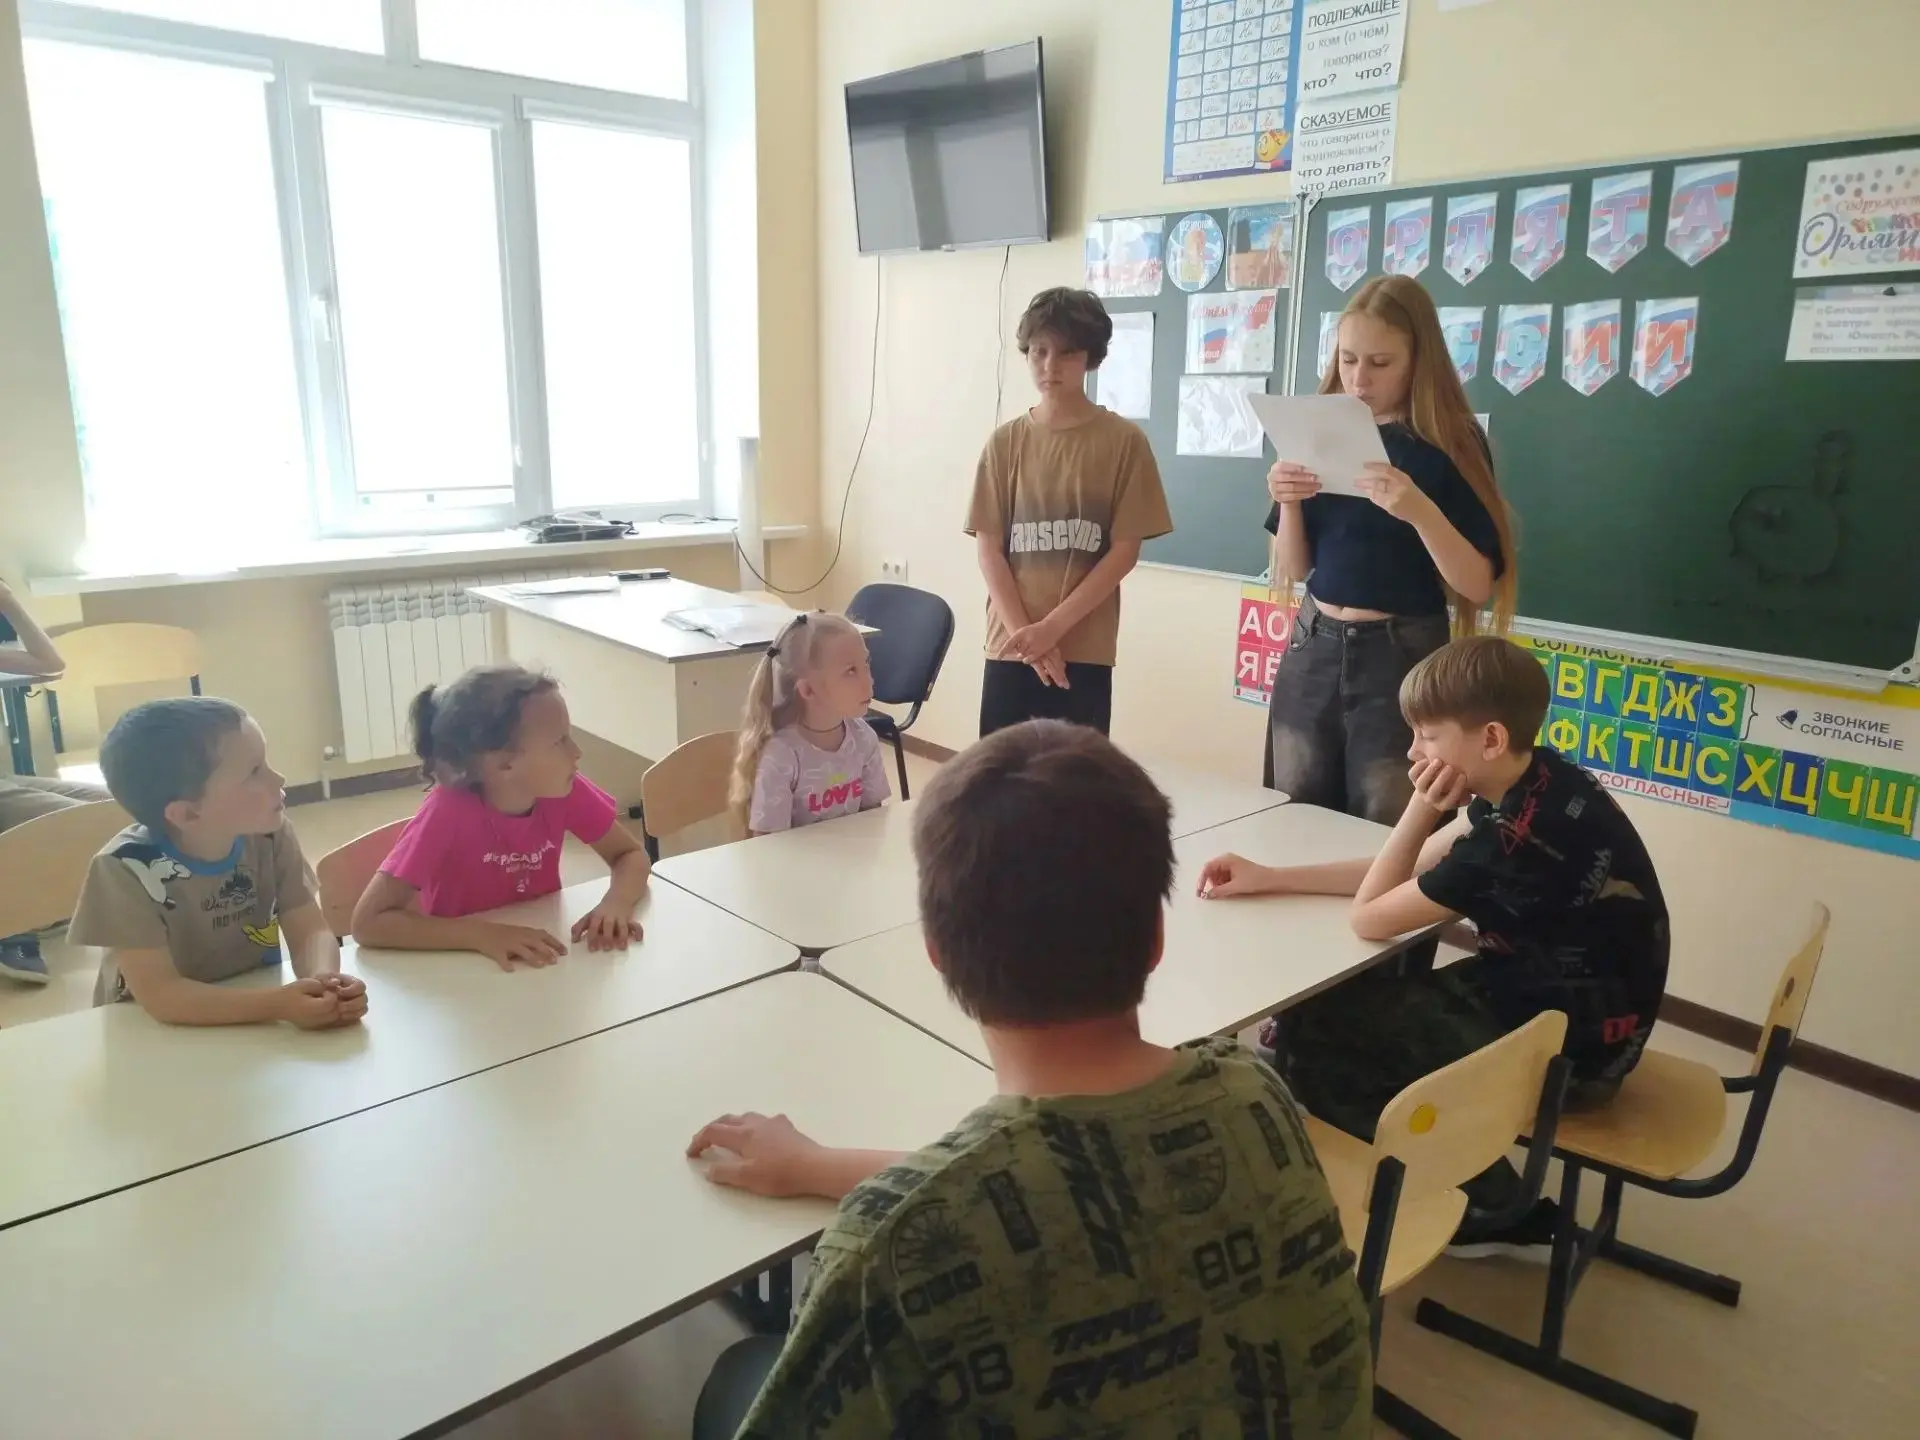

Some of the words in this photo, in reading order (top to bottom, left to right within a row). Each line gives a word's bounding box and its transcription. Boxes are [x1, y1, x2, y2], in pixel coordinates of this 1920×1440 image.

[1308, 0, 1400, 28] ПОДЛЕЖАЩЕЕ
[1304, 73, 1337, 91] кто?
[1356, 62, 1392, 80] что?
[1300, 102, 1391, 129] СКАЗУЕМОЕ
[1298, 168, 1323, 178] что
[1326, 156, 1391, 176] делать?
[1301, 182, 1325, 191] что
[1329, 172, 1386, 191] делал?
[1800, 723, 1904, 751] СОГЛАСНЫЕ
[1812, 711, 1890, 735] ЗВОНКИЕ
[808, 778, 864, 812] LOVE
[1599, 772, 1719, 810] СОГЛАСНЫЕ
